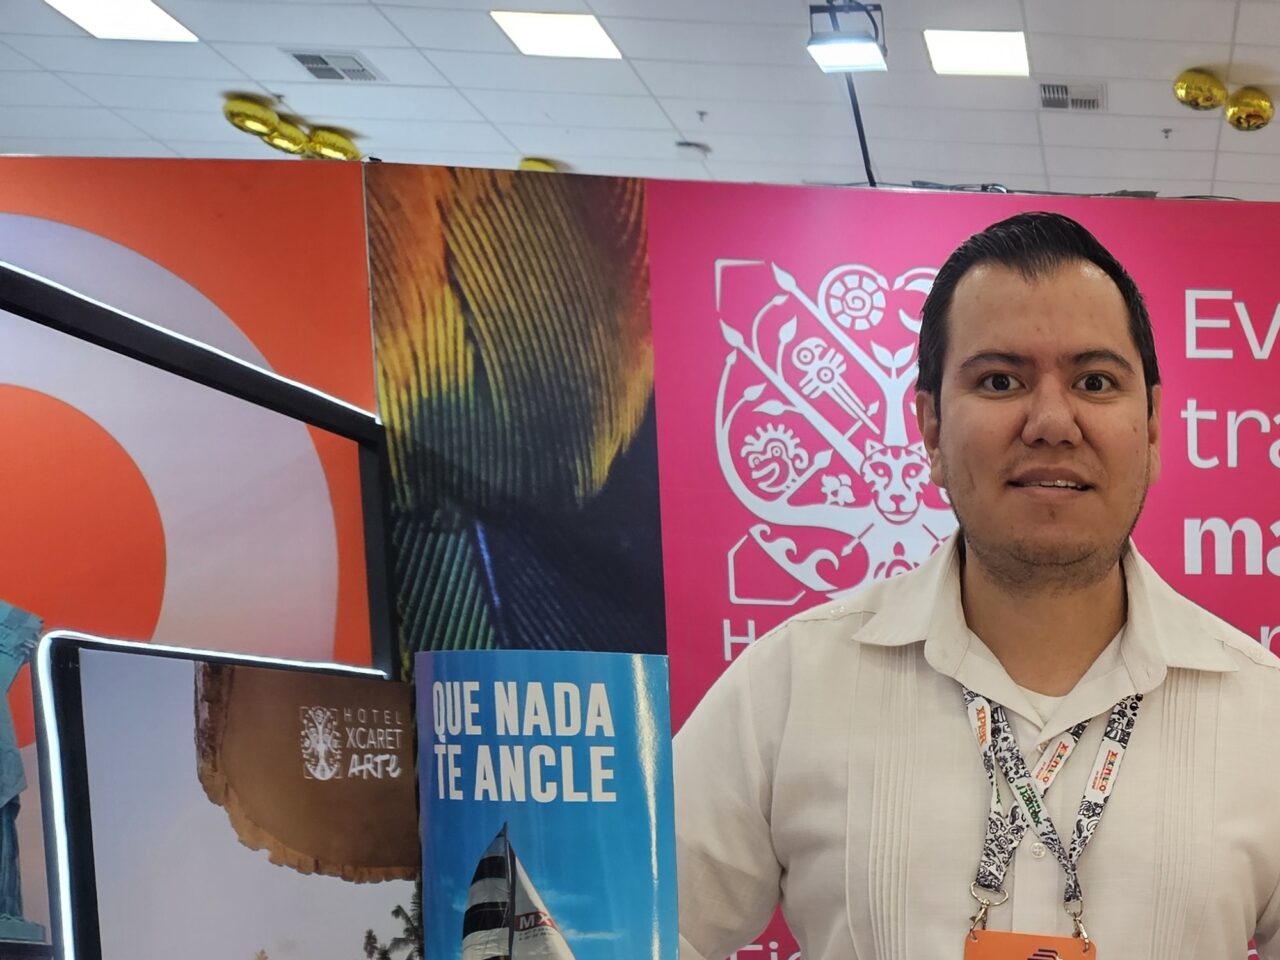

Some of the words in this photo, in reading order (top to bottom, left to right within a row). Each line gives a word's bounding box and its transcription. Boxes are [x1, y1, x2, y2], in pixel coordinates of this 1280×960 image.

[343, 707, 403, 725] HOTEL
[432, 681, 482, 743] QUE
[494, 681, 616, 737] NADA
[345, 727, 403, 749] XCARET
[434, 744, 464, 800] TE
[474, 744, 617, 803] ANCLE
